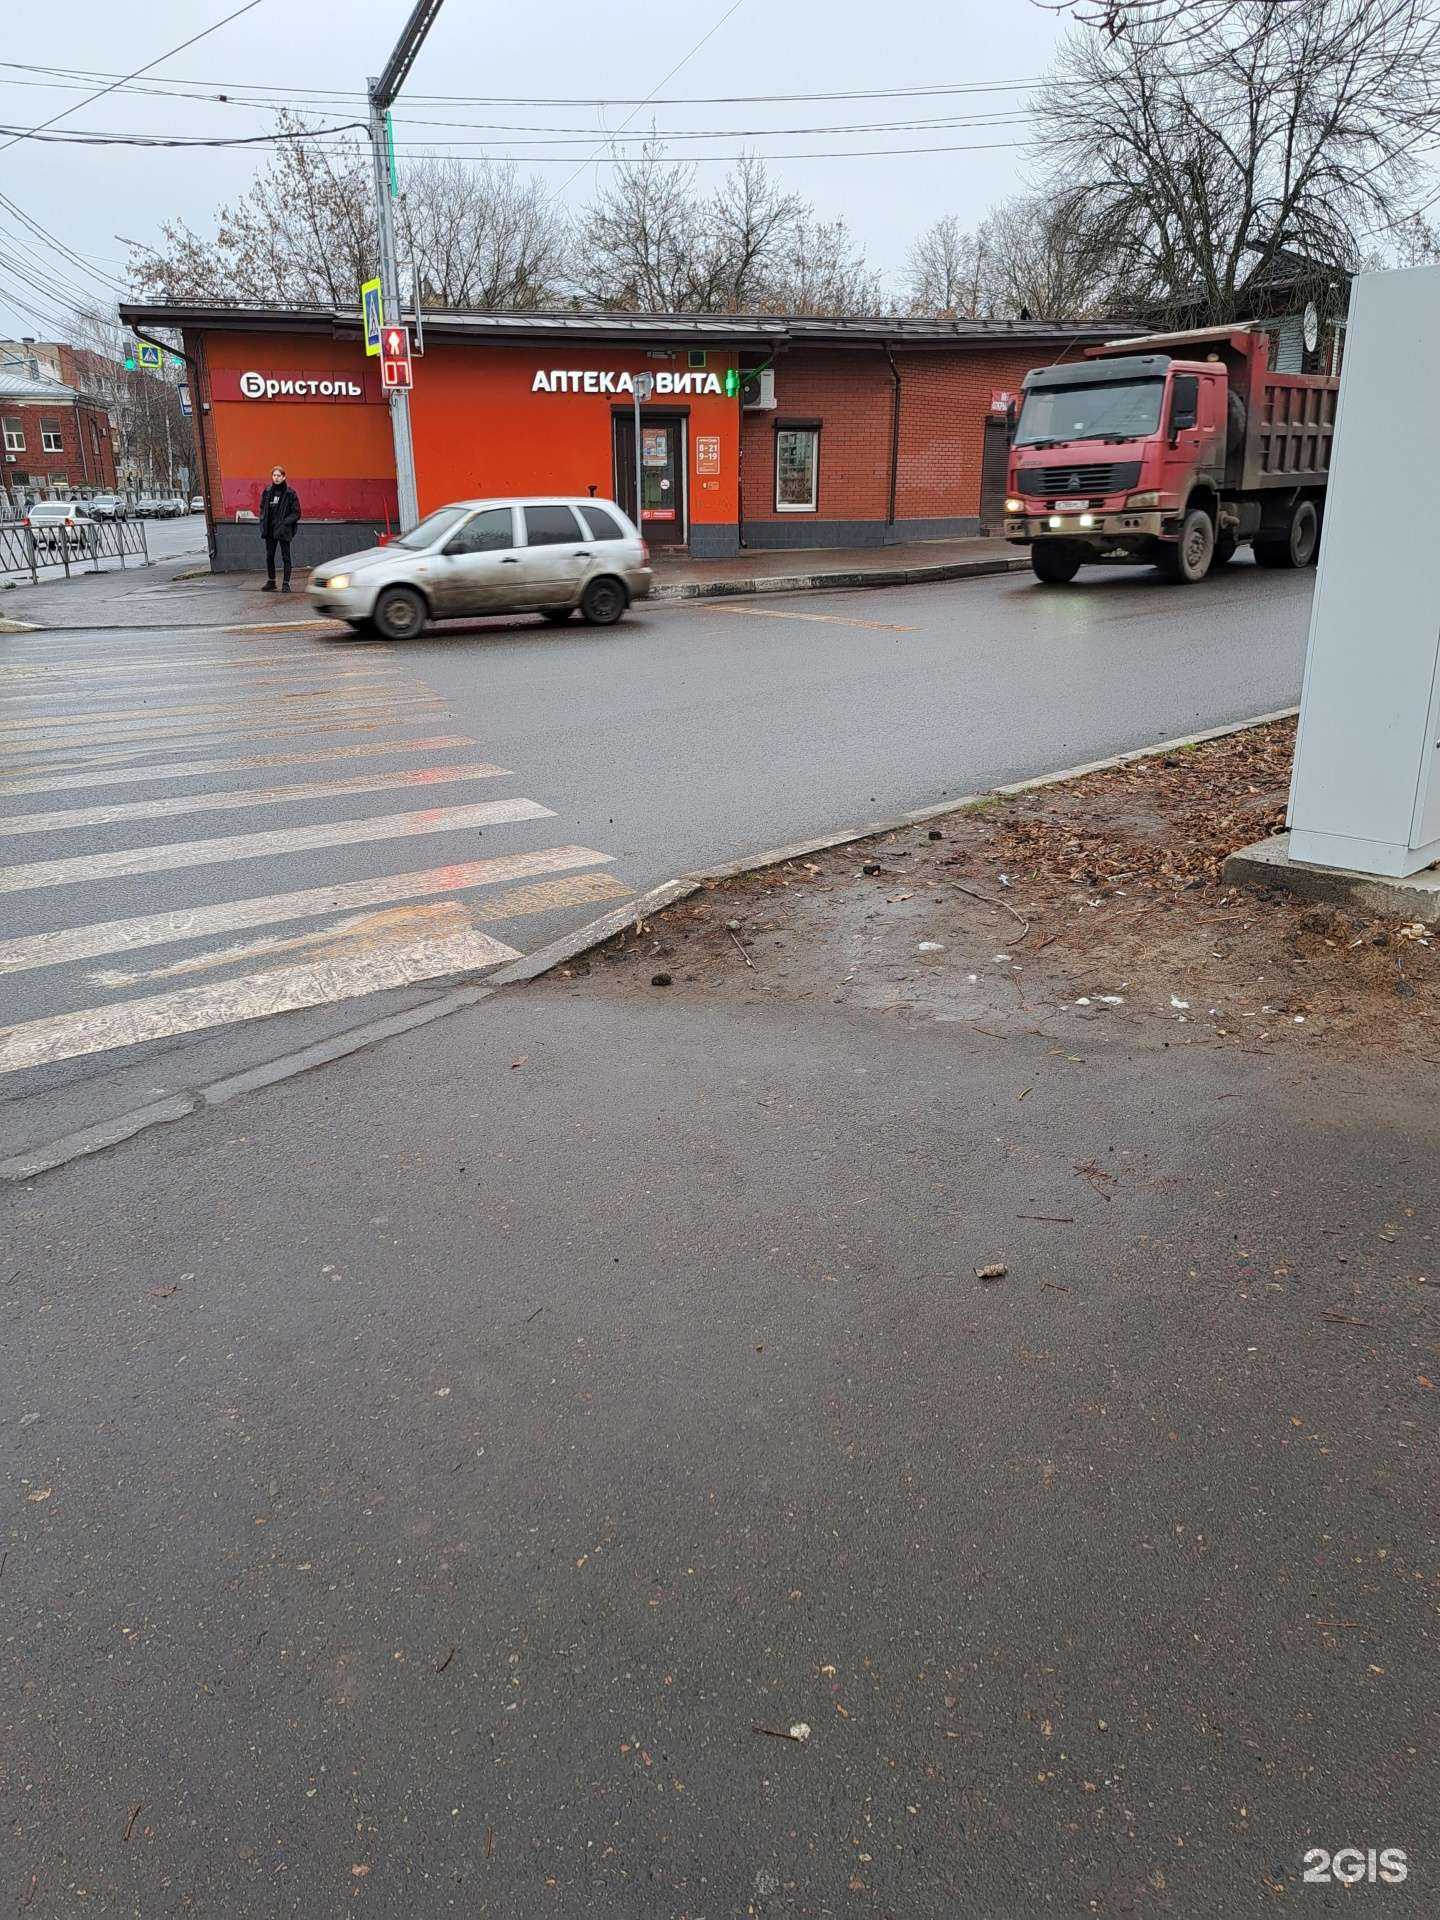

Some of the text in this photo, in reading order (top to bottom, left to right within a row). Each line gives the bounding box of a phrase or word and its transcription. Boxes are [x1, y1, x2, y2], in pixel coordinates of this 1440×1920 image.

[240, 371, 361, 398] Бристоль
[531, 370, 722, 394] АПТЕКА ВИТА
